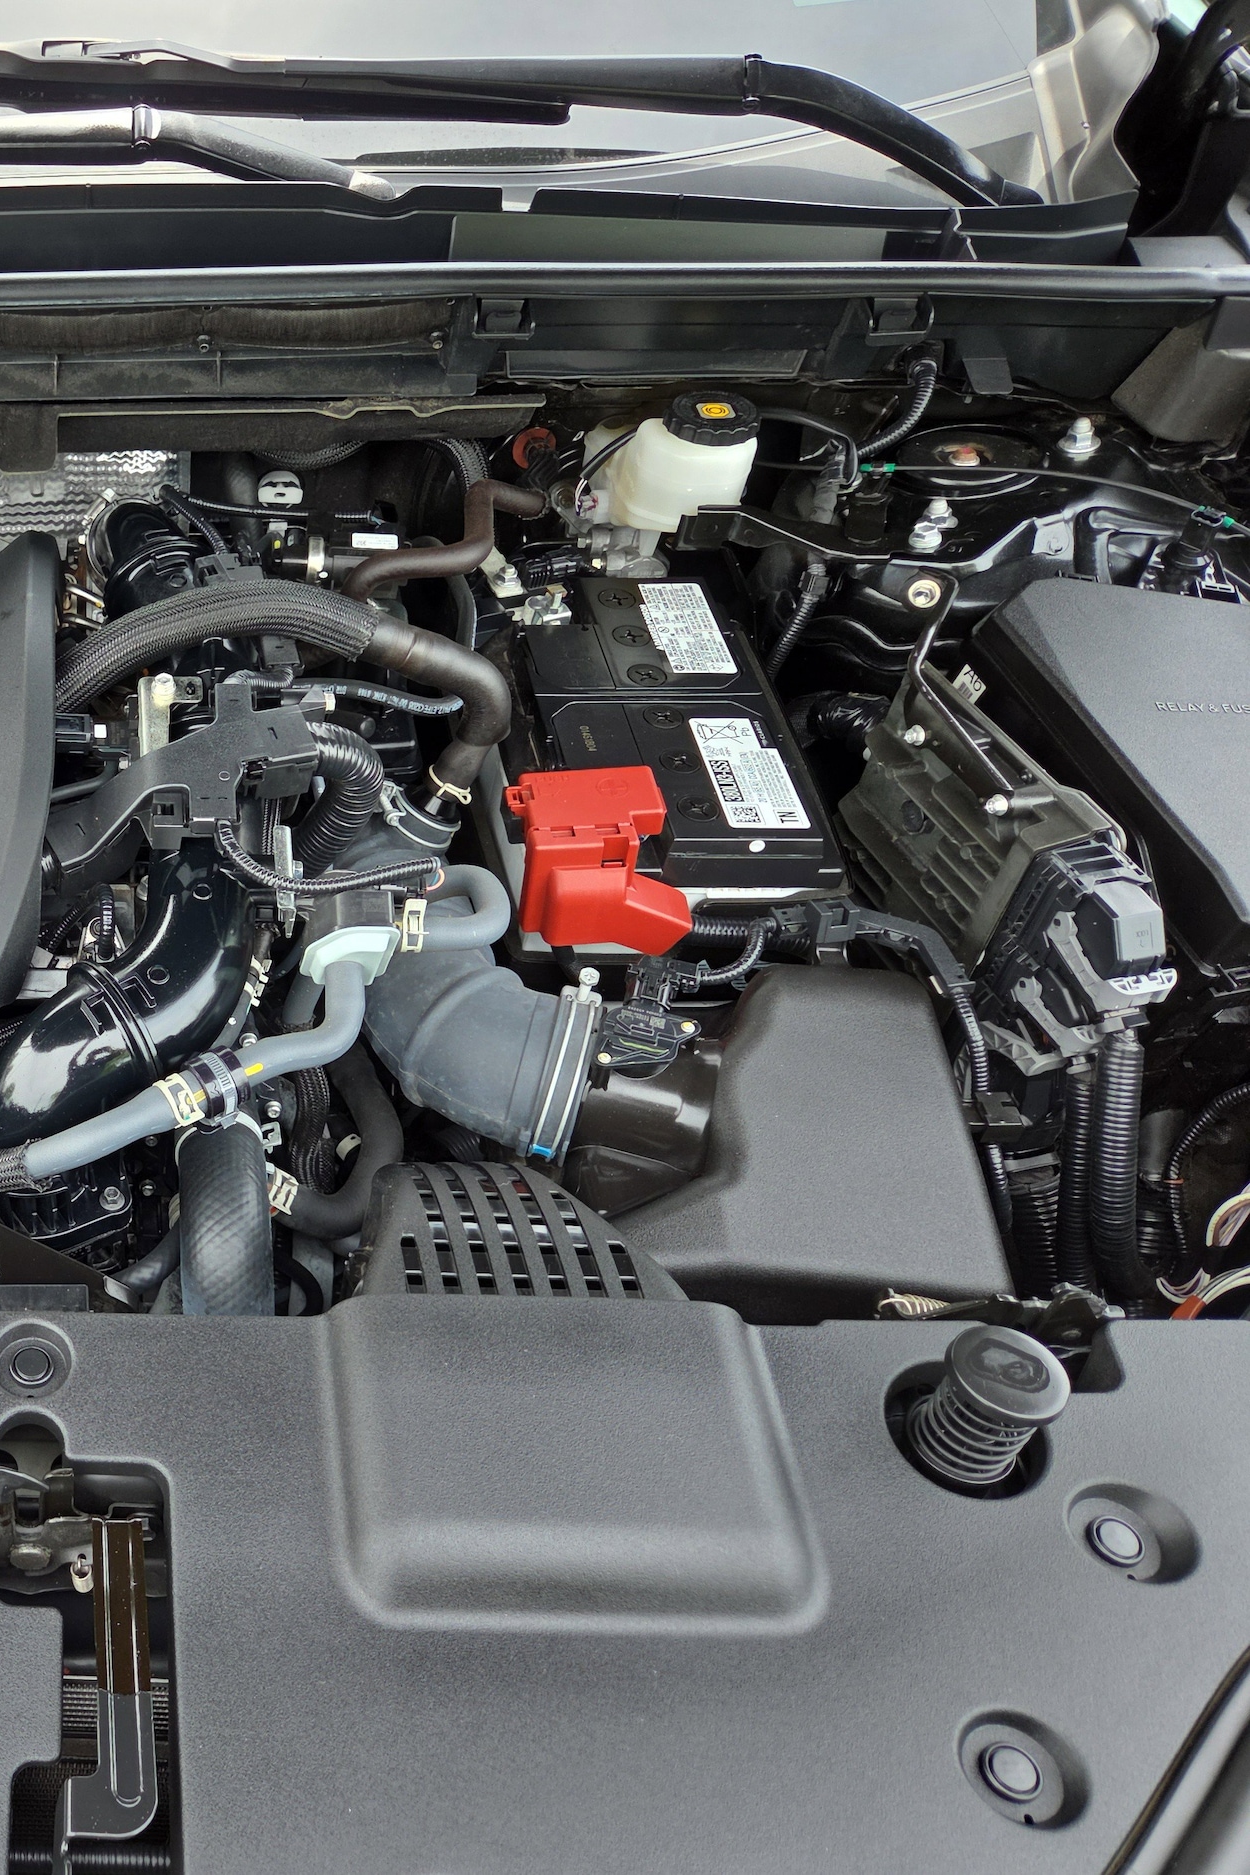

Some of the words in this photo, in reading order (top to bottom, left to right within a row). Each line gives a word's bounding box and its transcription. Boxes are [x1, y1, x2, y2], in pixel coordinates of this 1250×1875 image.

[1155, 701, 1204, 713] RELAY
[1208, 703, 1219, 713] &
[1221, 703, 1250, 714] FUS
[740, 727, 752, 737] Pb
[777, 811, 799, 824] TN
